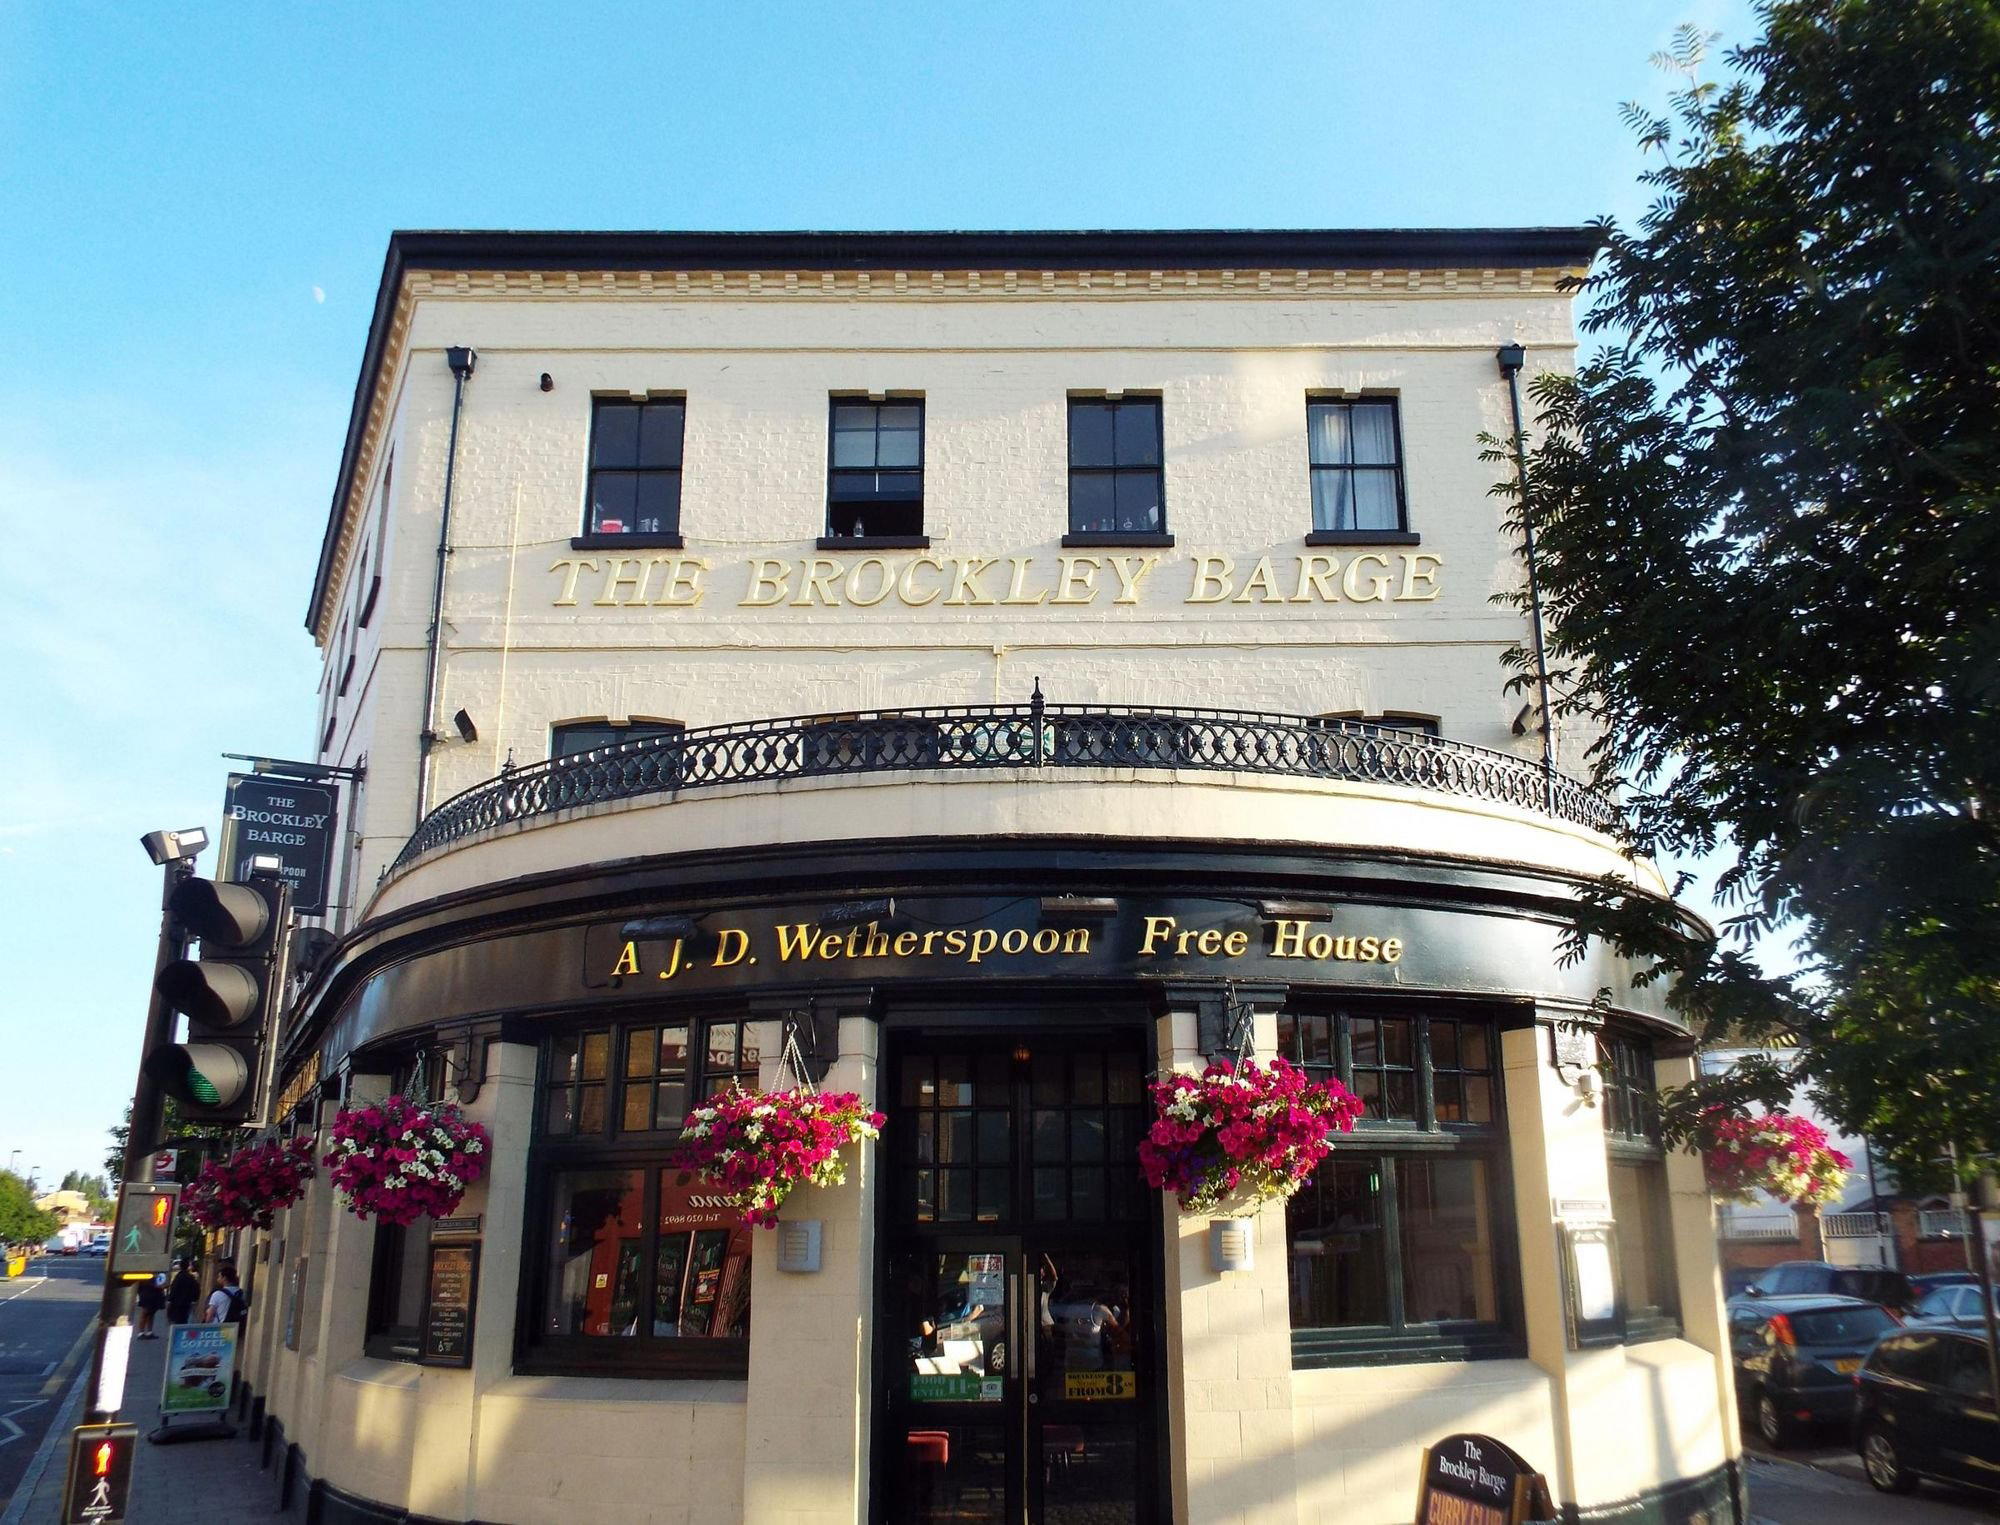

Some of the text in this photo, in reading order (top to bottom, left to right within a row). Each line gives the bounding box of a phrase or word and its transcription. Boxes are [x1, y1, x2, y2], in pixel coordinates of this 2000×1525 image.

[550, 552, 1443, 607] THE BROCKLEY BARGE
[267, 796, 296, 808] THE
[230, 805, 329, 829] BROCKLEY
[247, 829, 306, 846] BARGE
[611, 916, 1403, 980] A J. D. Wetherspoon Free House
[1068, 1387, 1106, 1396] FROM
[1105, 1373, 1124, 1395] 8
[1464, 1440, 1482, 1461] The
[1440, 1455, 1507, 1496] Brockley Barge
[1430, 1491, 1468, 1525] CURRY
